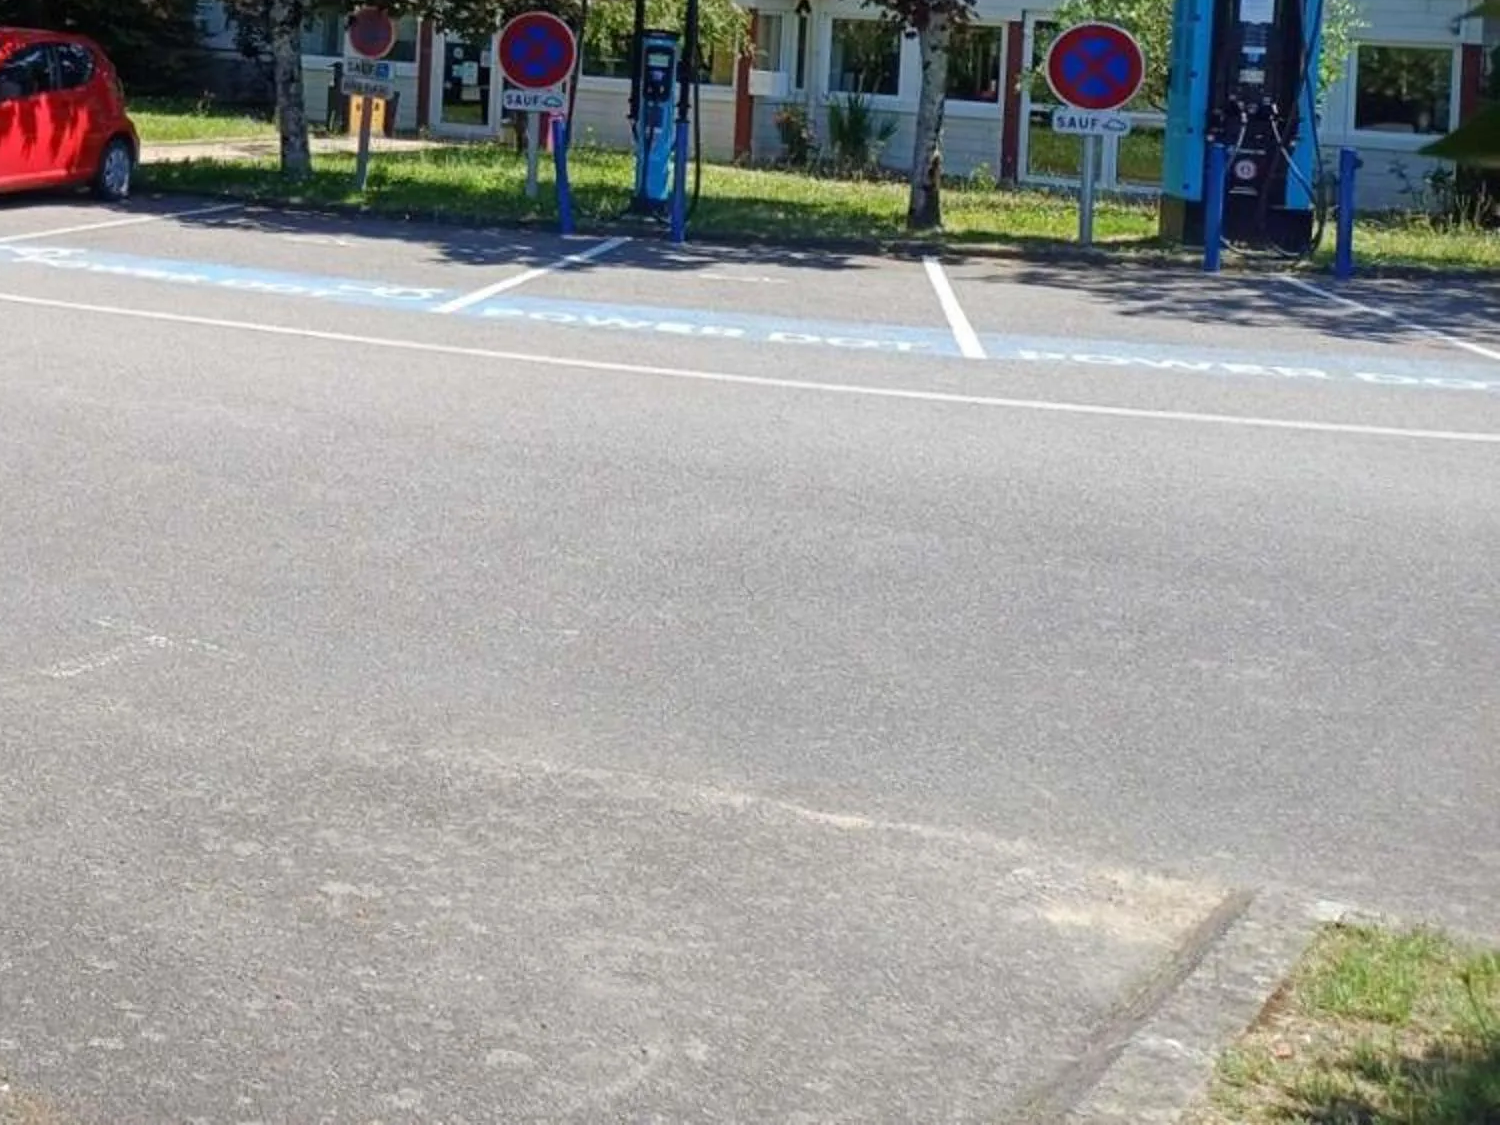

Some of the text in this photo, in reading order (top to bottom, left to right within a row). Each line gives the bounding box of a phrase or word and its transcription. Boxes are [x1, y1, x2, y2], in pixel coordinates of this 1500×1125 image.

[505, 94, 540, 107] SAUF
[1056, 115, 1100, 129] SAUF
[483, 307, 929, 352] POWER DOT
[1018, 349, 1327, 379] POWER
